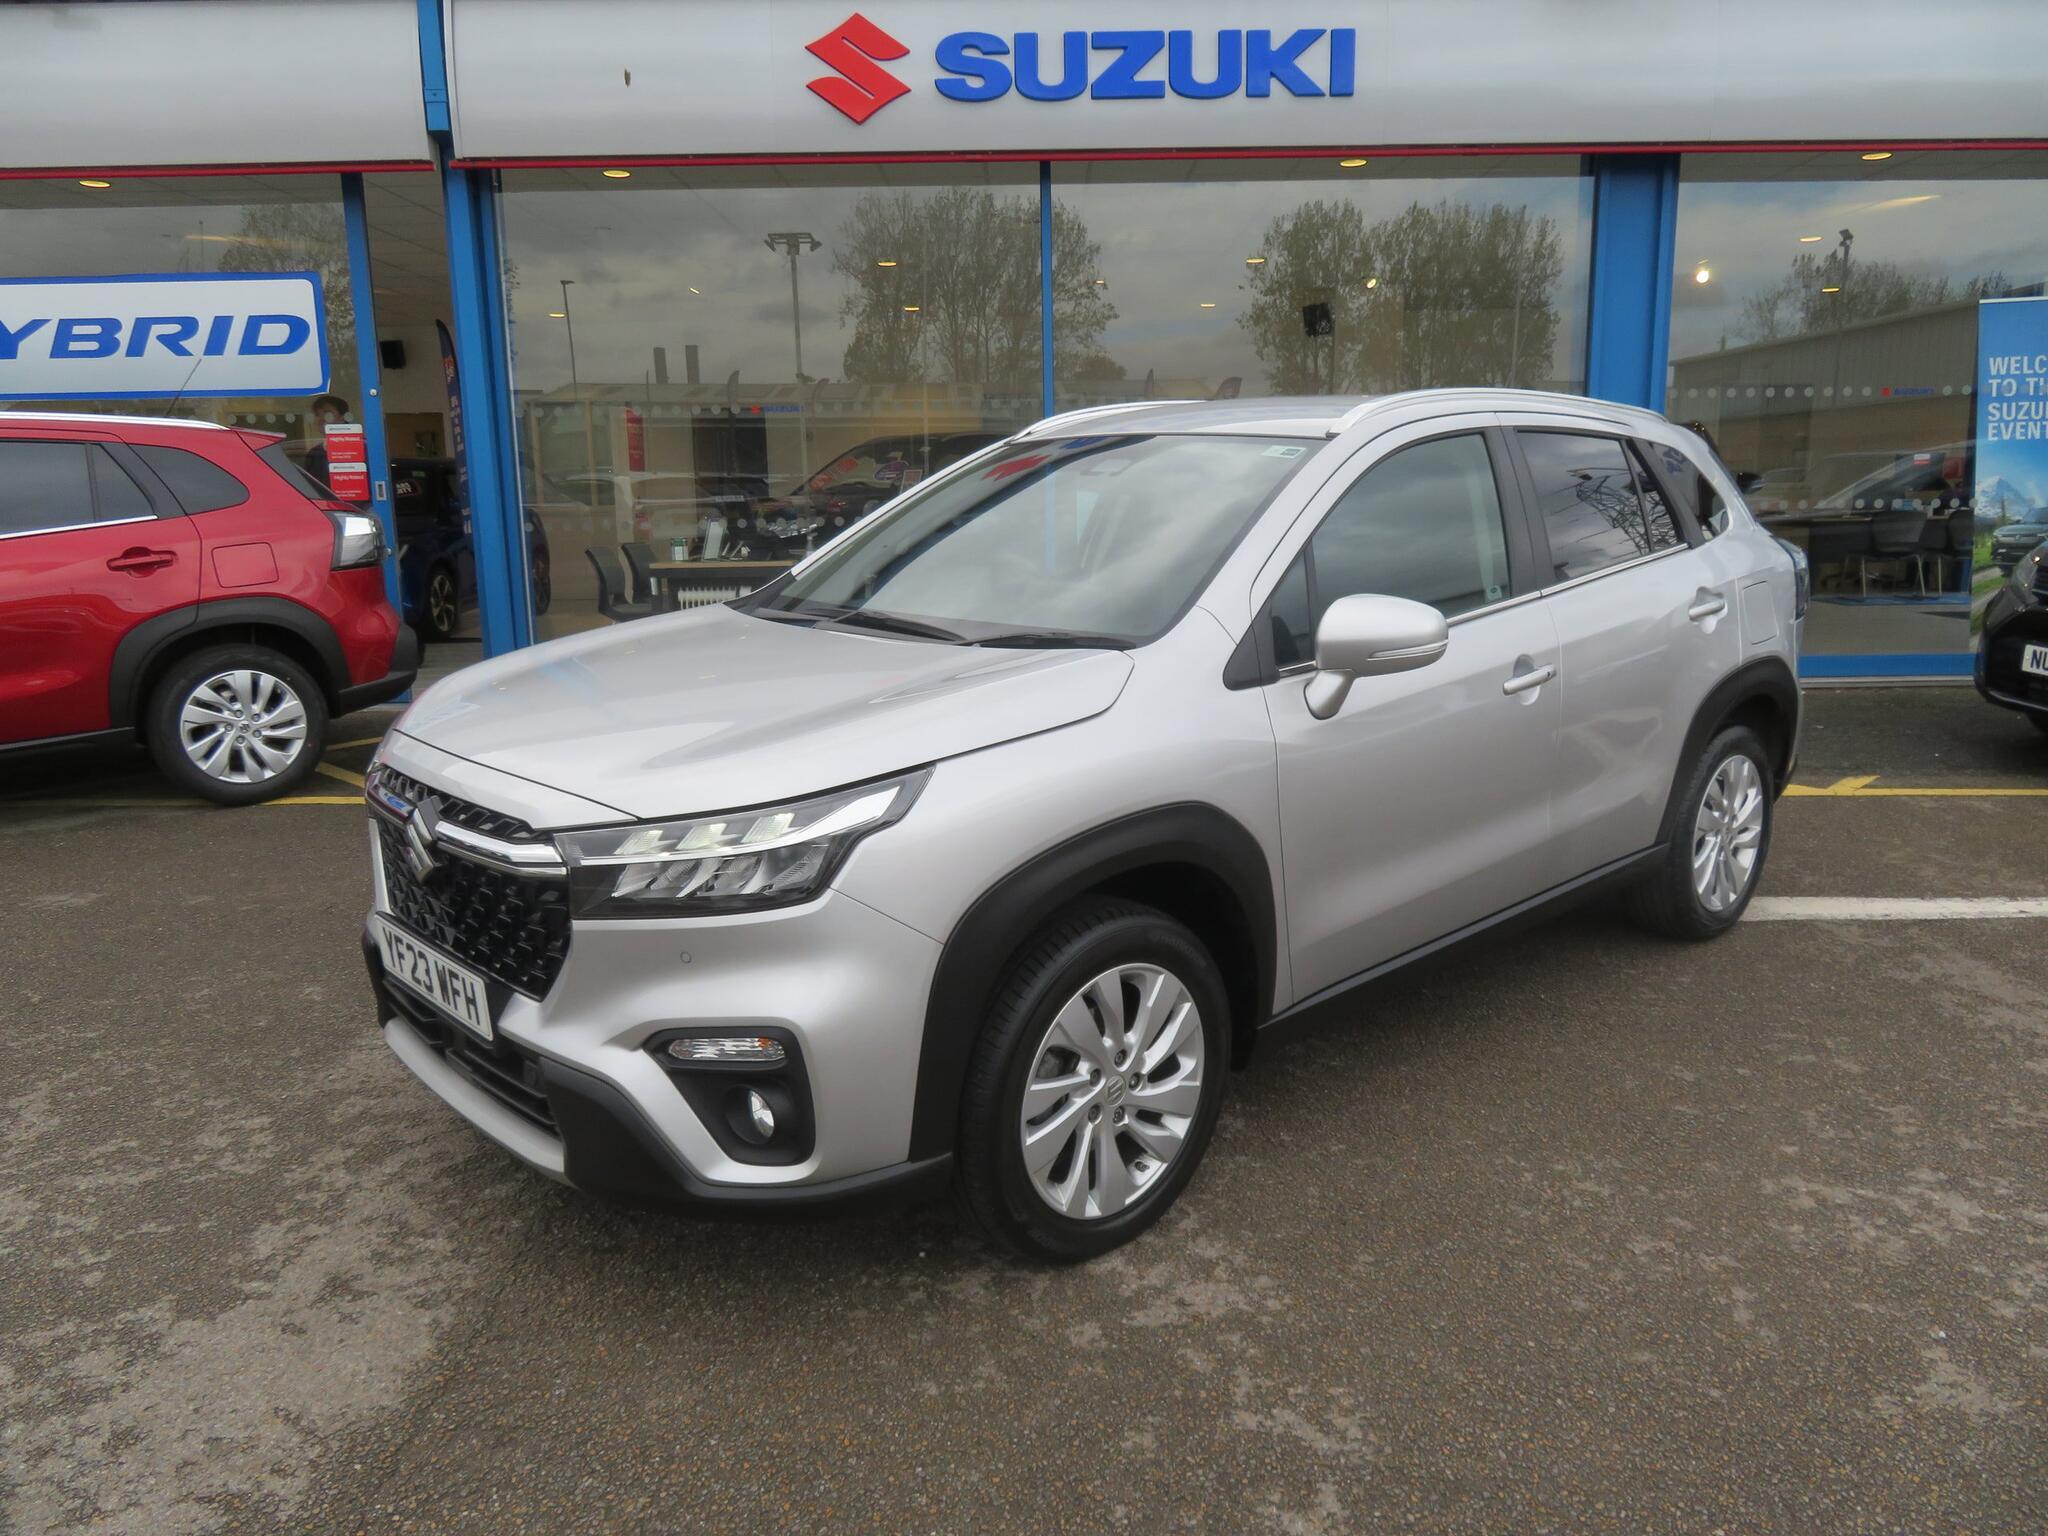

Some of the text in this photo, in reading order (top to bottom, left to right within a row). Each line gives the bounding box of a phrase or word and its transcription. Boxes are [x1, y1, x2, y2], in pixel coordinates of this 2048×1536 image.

[934, 28, 1356, 101] SUZUKI
[1987, 401, 2048, 420] SUZU
[1988, 378, 2017, 397] TO
[382, 926, 480, 1026] YF23 WFH
